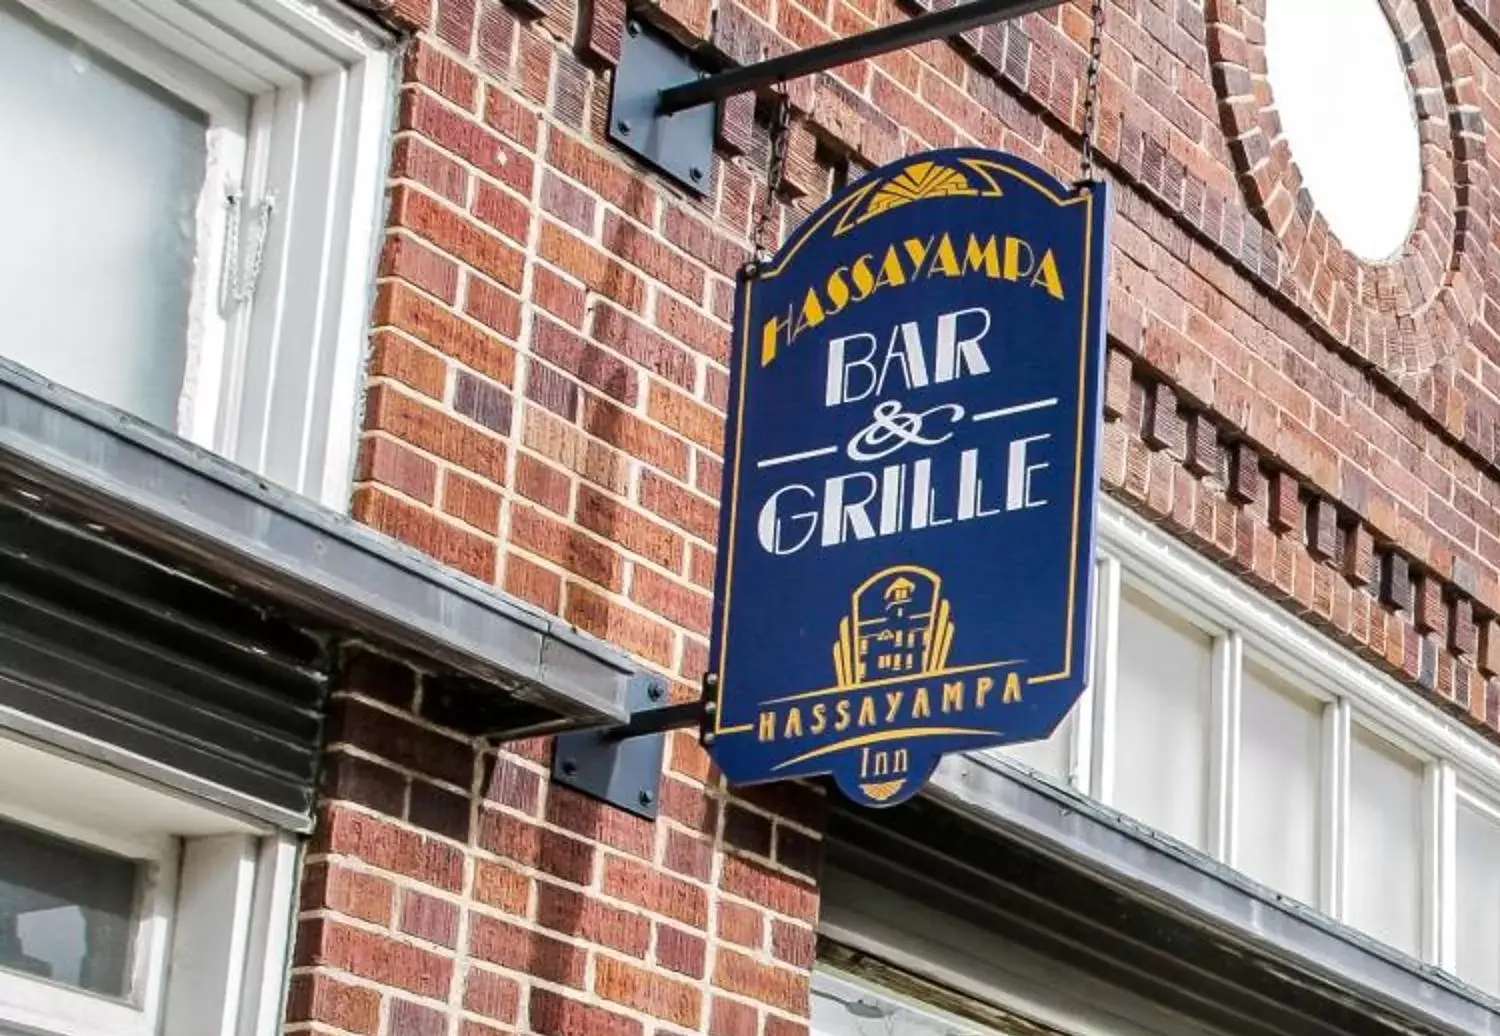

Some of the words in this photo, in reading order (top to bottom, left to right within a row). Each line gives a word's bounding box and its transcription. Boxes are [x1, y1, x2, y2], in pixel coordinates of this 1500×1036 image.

[760, 232, 1065, 366] HASSAYAMPA
[825, 307, 991, 407] BAR
[847, 400, 965, 461] &
[757, 433, 1052, 555] GRILLE
[758, 671, 1023, 742] HASSAYAMPA
[859, 747, 908, 779] Inn
